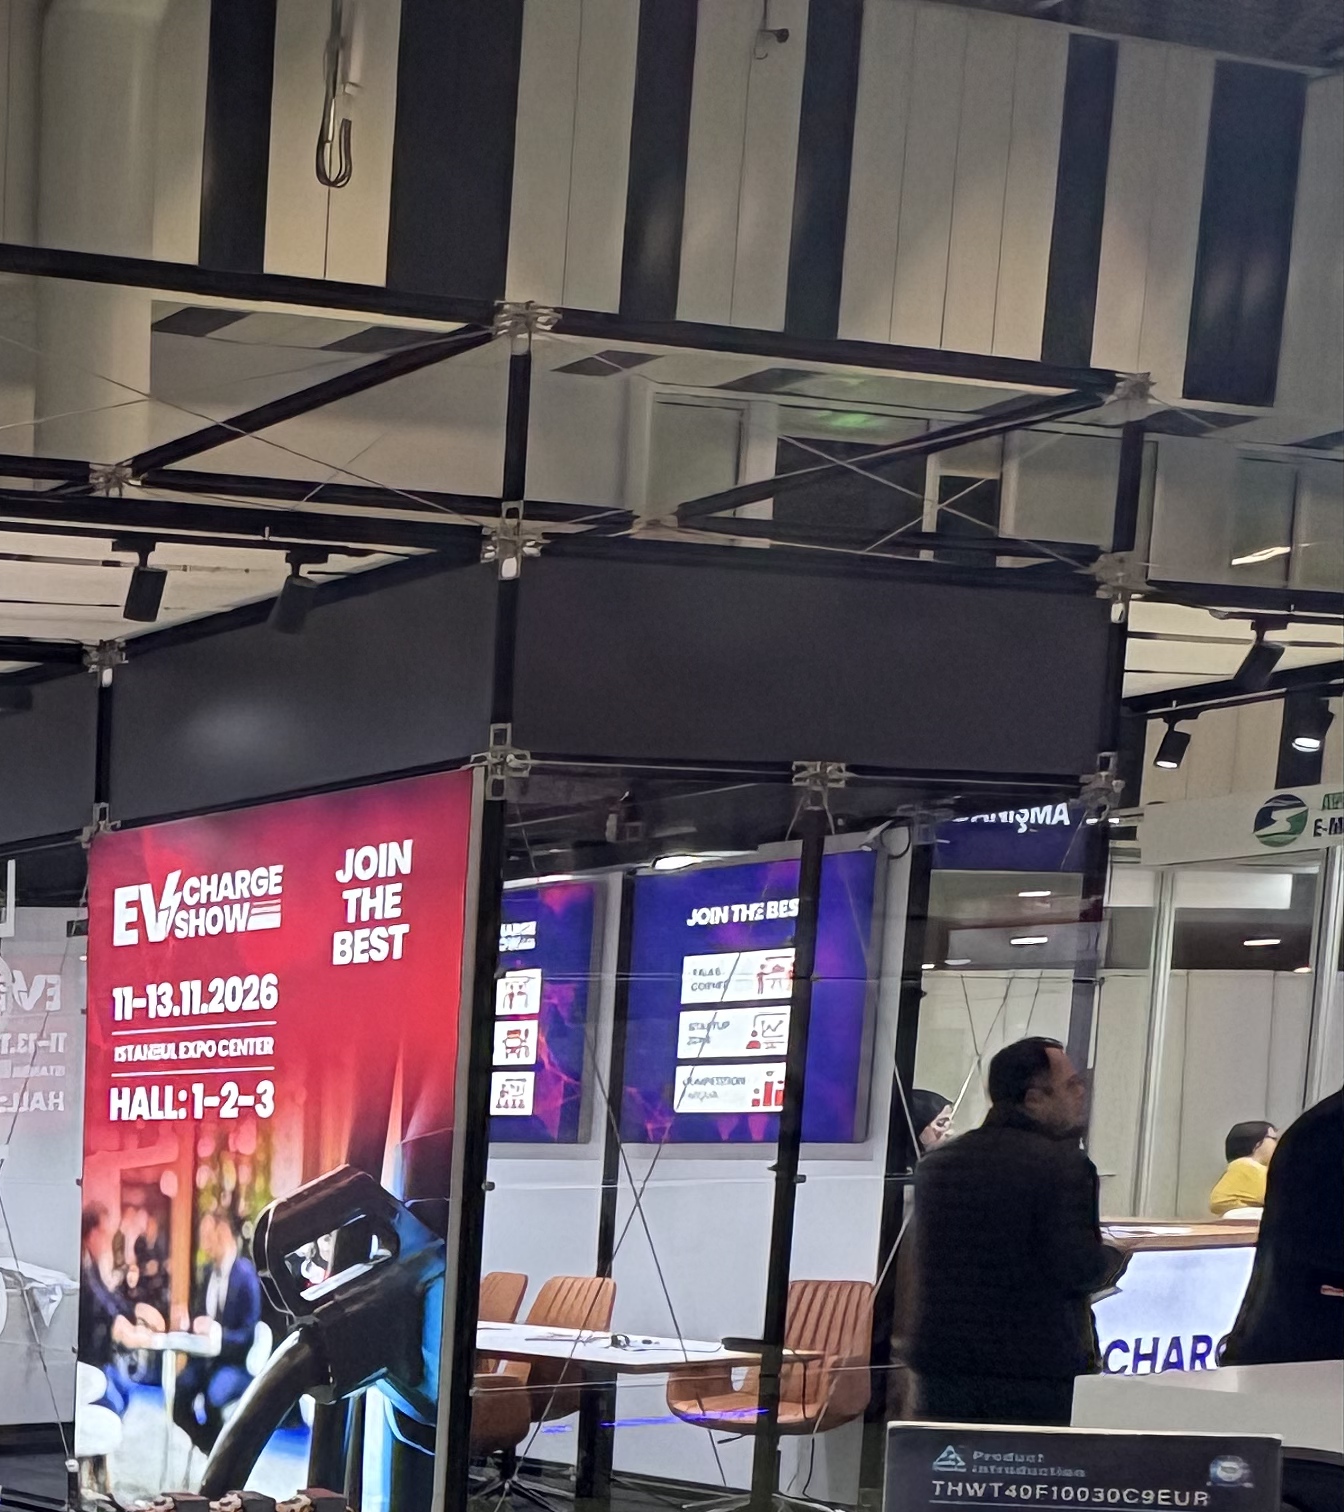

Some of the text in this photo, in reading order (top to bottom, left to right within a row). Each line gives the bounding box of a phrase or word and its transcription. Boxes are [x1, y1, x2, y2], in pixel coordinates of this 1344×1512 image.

[335, 839, 412, 883] JOIN
[113, 864, 284, 947] EV CHARGE
[174, 902, 250, 939] SHOW
[342, 882, 403, 923] THE
[686, 898, 800, 926] JOIN THE BES
[332, 923, 410, 965] BEST
[113, 973, 279, 1021] 11-13.11.2026
[114, 1037, 275, 1062] ISTANBUL EXPO CENTER
[109, 1080, 275, 1121] HALL: 1-2-3
